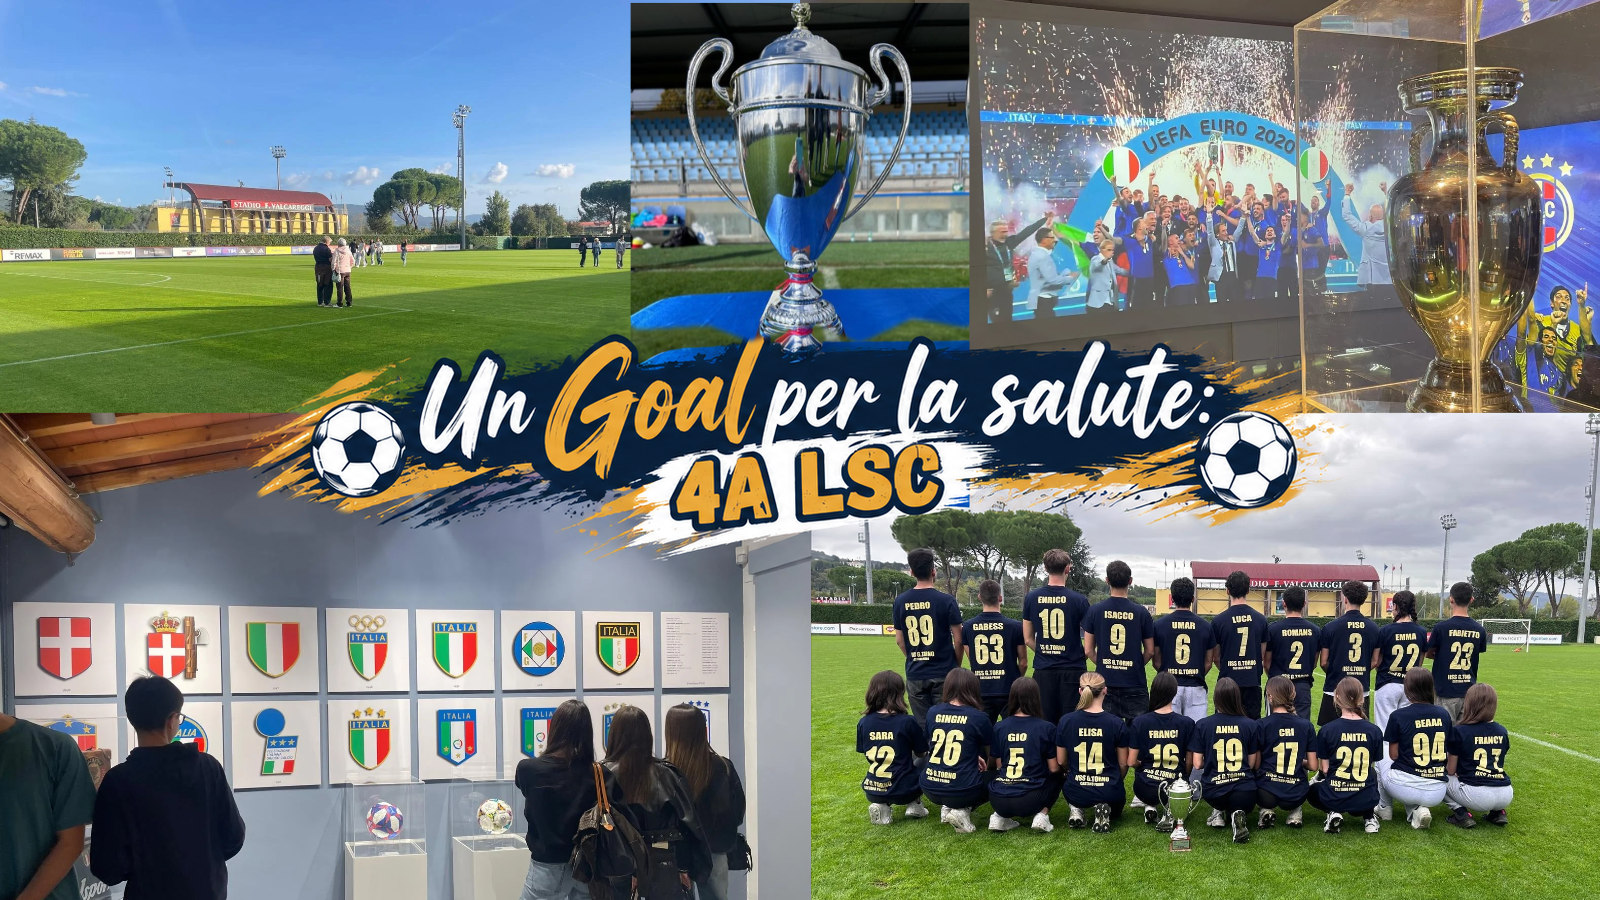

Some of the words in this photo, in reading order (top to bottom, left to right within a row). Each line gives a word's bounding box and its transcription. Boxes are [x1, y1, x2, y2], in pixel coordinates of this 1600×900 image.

[1009, 112, 1037, 124] ITALY
[1142, 124, 1192, 154] UEFA
[1200, 119, 1248, 137] EURO
[1254, 125, 1296, 155] 2020
[233, 201, 261, 209] STADIO
[271, 203, 313, 211] VALCAREGGI
[1251, 580, 1269, 588] DIO
[1037, 595, 1067, 604] ENRICO
[904, 601, 931, 611] PEDRO
[1104, 610, 1134, 621] ISACCO
[1231, 614, 1253, 624] LUCA
[436, 623, 475, 632] ITALIA
[972, 622, 1004, 631] GABESS
[1038, 607, 1065, 640] 10
[1171, 621, 1196, 630] UMAR
[1347, 621, 1366, 629] PISO
[603, 626, 637, 636] ITALIA
[905, 614, 934, 647] 89
[1281, 628, 1313, 637] ROMANS
[1448, 629, 1481, 639] FABIETTO
[351, 633, 386, 642] ITALIA
[1109, 623, 1126, 656] 9
[1236, 626, 1249, 657] 7
[1395, 632, 1417, 641] EMMA
[974, 633, 1004, 665] 63
[1174, 633, 1191, 665] 6
[1348, 632, 1363, 663] 3
[1288, 640, 1304, 670] 2
[1389, 643, 1420, 672] 22
[1449, 641, 1475, 671] 23
[443, 712, 471, 720] ITALIA
[935, 713, 968, 725] GINGIN
[352, 720, 389, 729] ITALIA
[1414, 718, 1443, 729] BEAAA
[175, 728, 197, 738] ALIA
[1078, 727, 1103, 737] ELISA
[1148, 729, 1179, 739] FRANCI
[1215, 725, 1240, 734] ANNA
[1278, 727, 1295, 737] CRI
[868, 731, 894, 741] SARA
[1007, 732, 1028, 742] GIO
[1340, 732, 1368, 742] ANITA
[1474, 735, 1504, 745] FRANCY
[928, 728, 965, 767] 26
[1412, 731, 1447, 767] 94
[1073, 741, 1105, 775] 14
[1148, 743, 1180, 770] 16
[1212, 737, 1244, 773] 19
[1272, 741, 1299, 776] 17
[865, 745, 896, 779] 12
[1005, 747, 1026, 779] 5
[1334, 745, 1371, 782] 20
